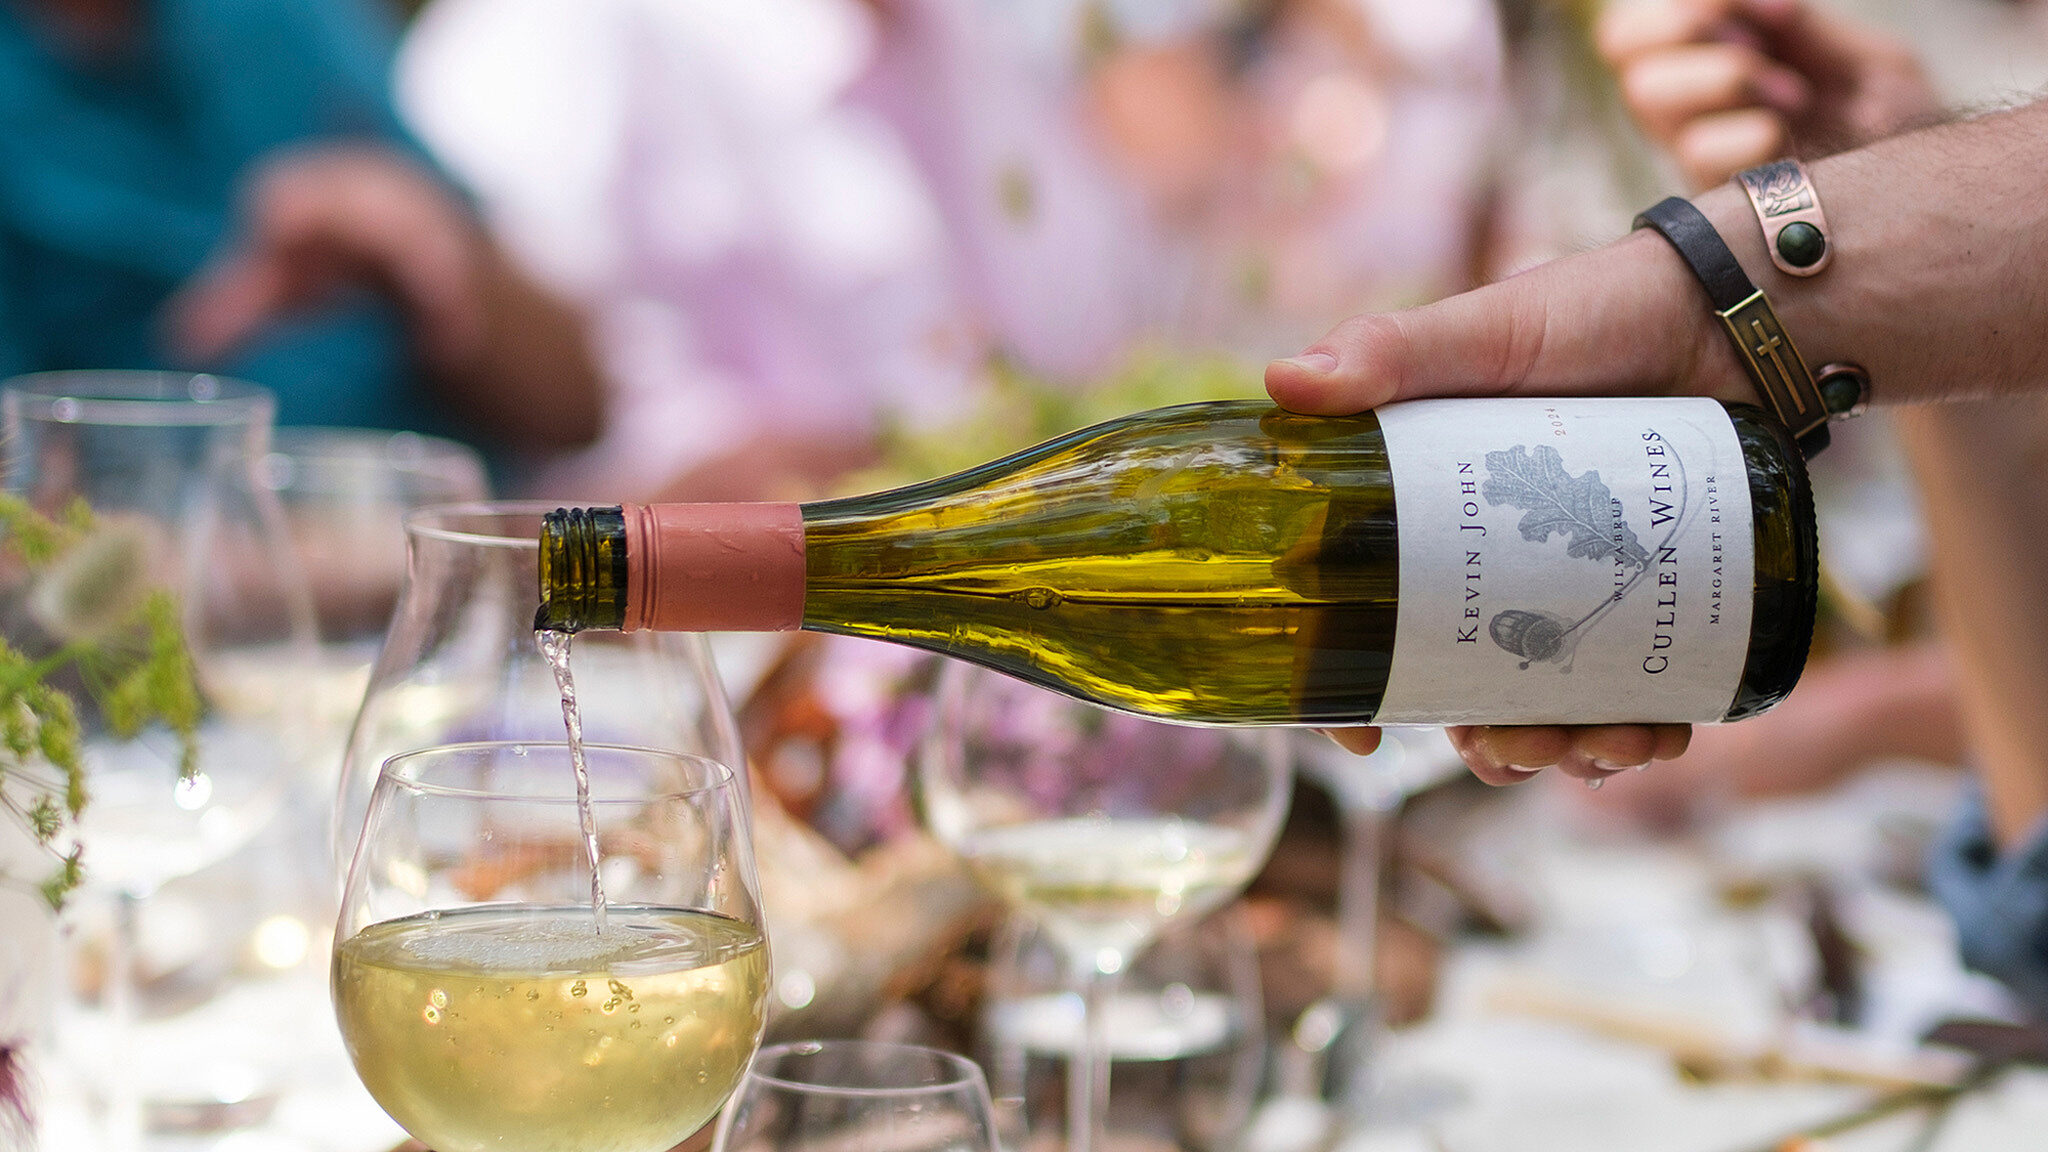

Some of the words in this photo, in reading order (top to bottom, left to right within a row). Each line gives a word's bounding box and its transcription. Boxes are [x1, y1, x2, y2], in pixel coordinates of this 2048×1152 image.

[1457, 461, 1487, 537] JOHN
[1642, 430, 1676, 530] WINES
[1706, 475, 1720, 524] RIVER
[1611, 497, 1625, 602] WILYABRUP
[1709, 532, 1722, 625] MARGARET
[1456, 550, 1482, 645] KEVIN
[1642, 546, 1678, 675] CULLEN
